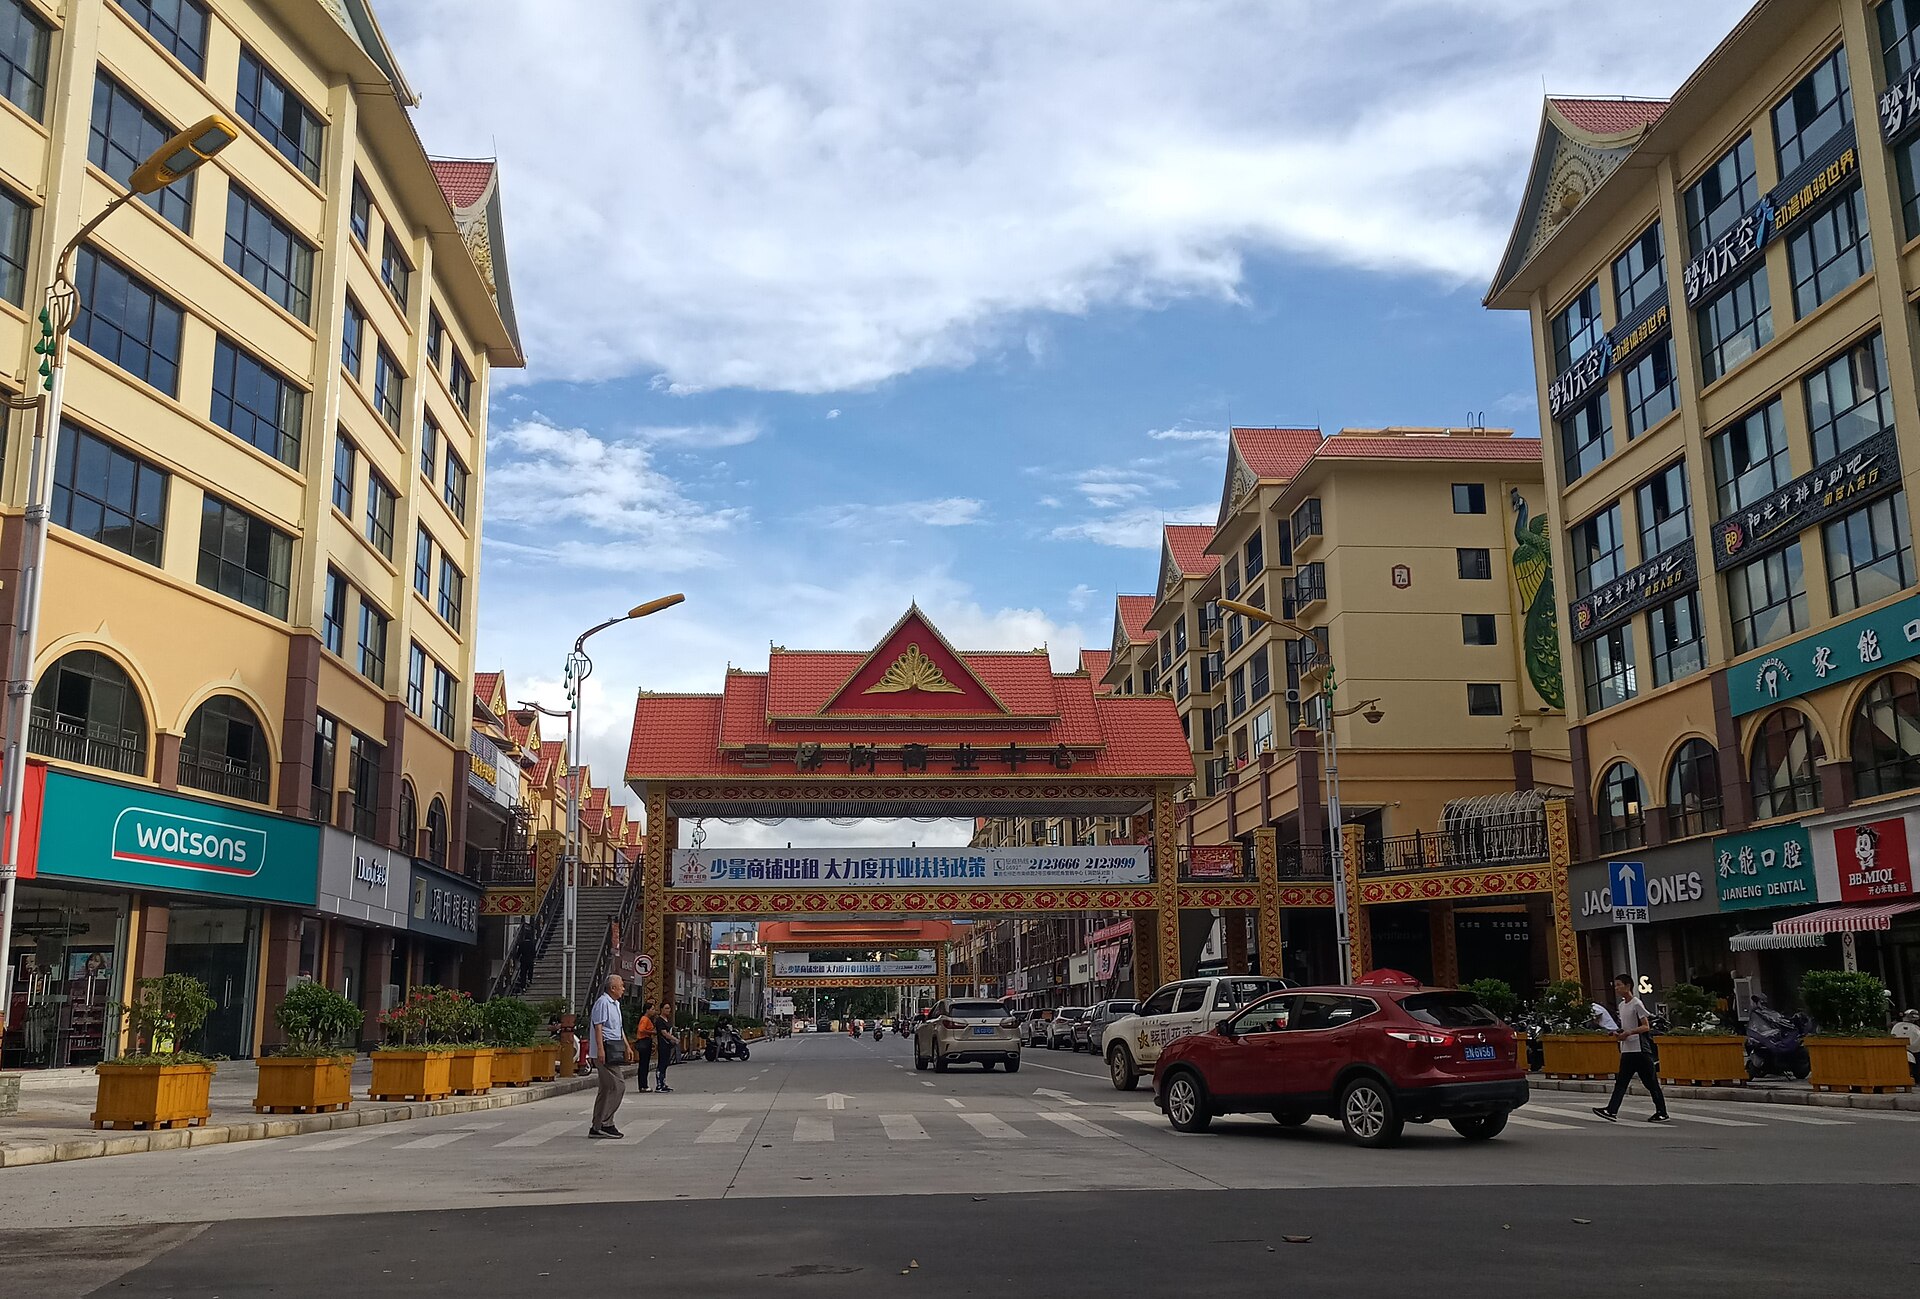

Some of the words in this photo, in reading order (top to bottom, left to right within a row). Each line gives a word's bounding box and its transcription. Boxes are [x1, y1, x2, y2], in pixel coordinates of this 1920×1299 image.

[1775, 148, 1855, 230] 动漫体验世界
[1684, 216, 1756, 302] 梦幻天空
[1612, 305, 1667, 364] 动漫体验世界
[1549, 349, 1600, 416] 梦幻天空
[1747, 453, 1879, 538] 阳光牛排自助吧
[136, 822, 247, 862] watsons
[1718, 840, 1802, 878] 家能口腔
[710, 858, 819, 880] 少量商铺出租
[824, 856, 986, 880] 大力度开业扶持政策
[1028, 857, 1080, 870] 2123666
[1085, 857, 1136, 869] 2123999
[1647, 871, 1702, 906] ONES
[1722, 885, 1762, 901] JIANENG
[1768, 879, 1806, 896] DENTAL
[1615, 908, 1647, 921] 单行路
[1638, 976, 1653, 994] &
